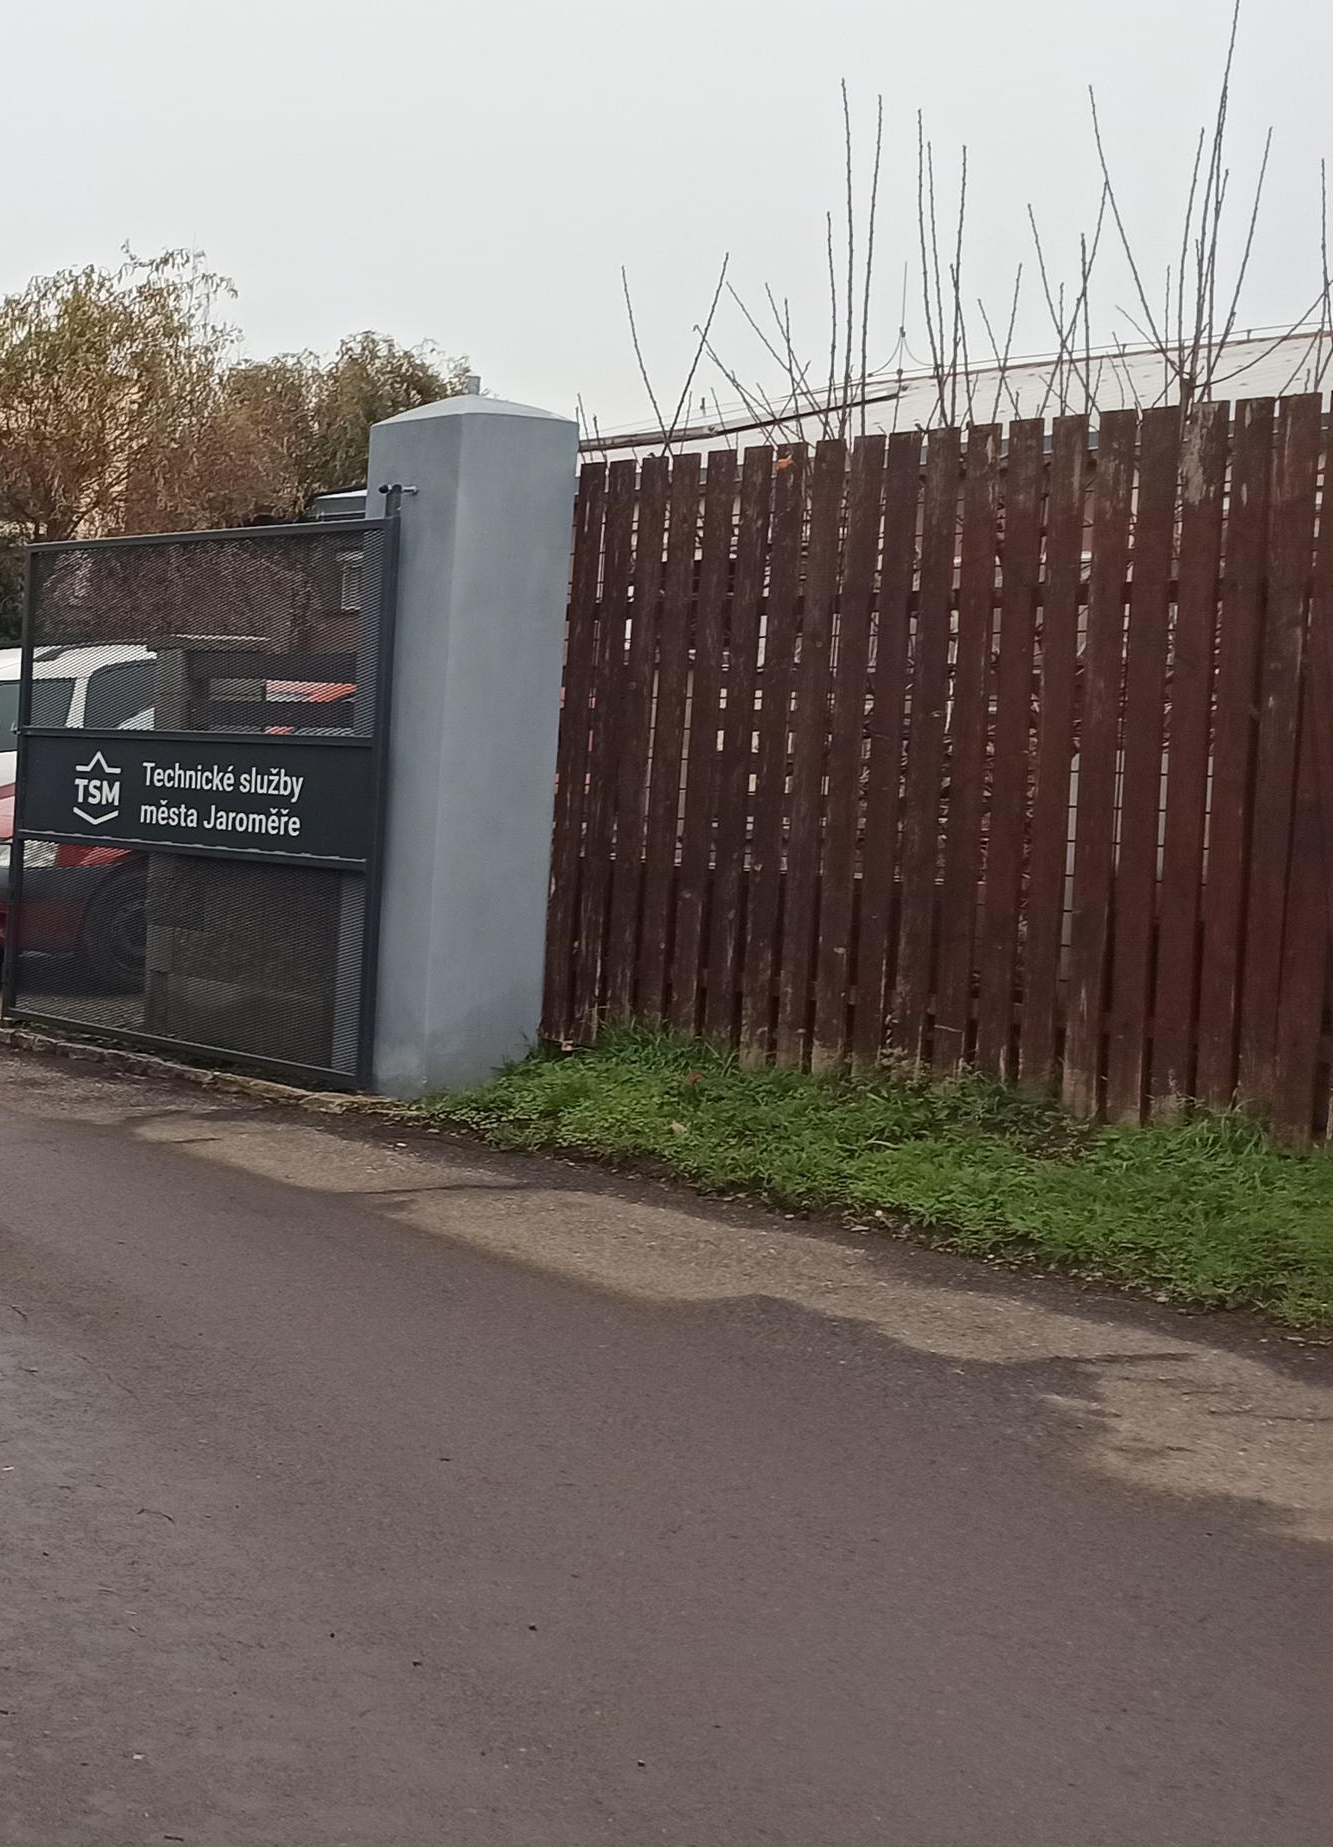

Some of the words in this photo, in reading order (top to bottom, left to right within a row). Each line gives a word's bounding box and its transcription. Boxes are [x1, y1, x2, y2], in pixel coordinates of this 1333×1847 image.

[74, 778, 121, 806] TSM
[142, 761, 235, 792] Technické
[239, 766, 304, 803] služby
[140, 799, 198, 828] města
[203, 803, 301, 837] Jaroměře
